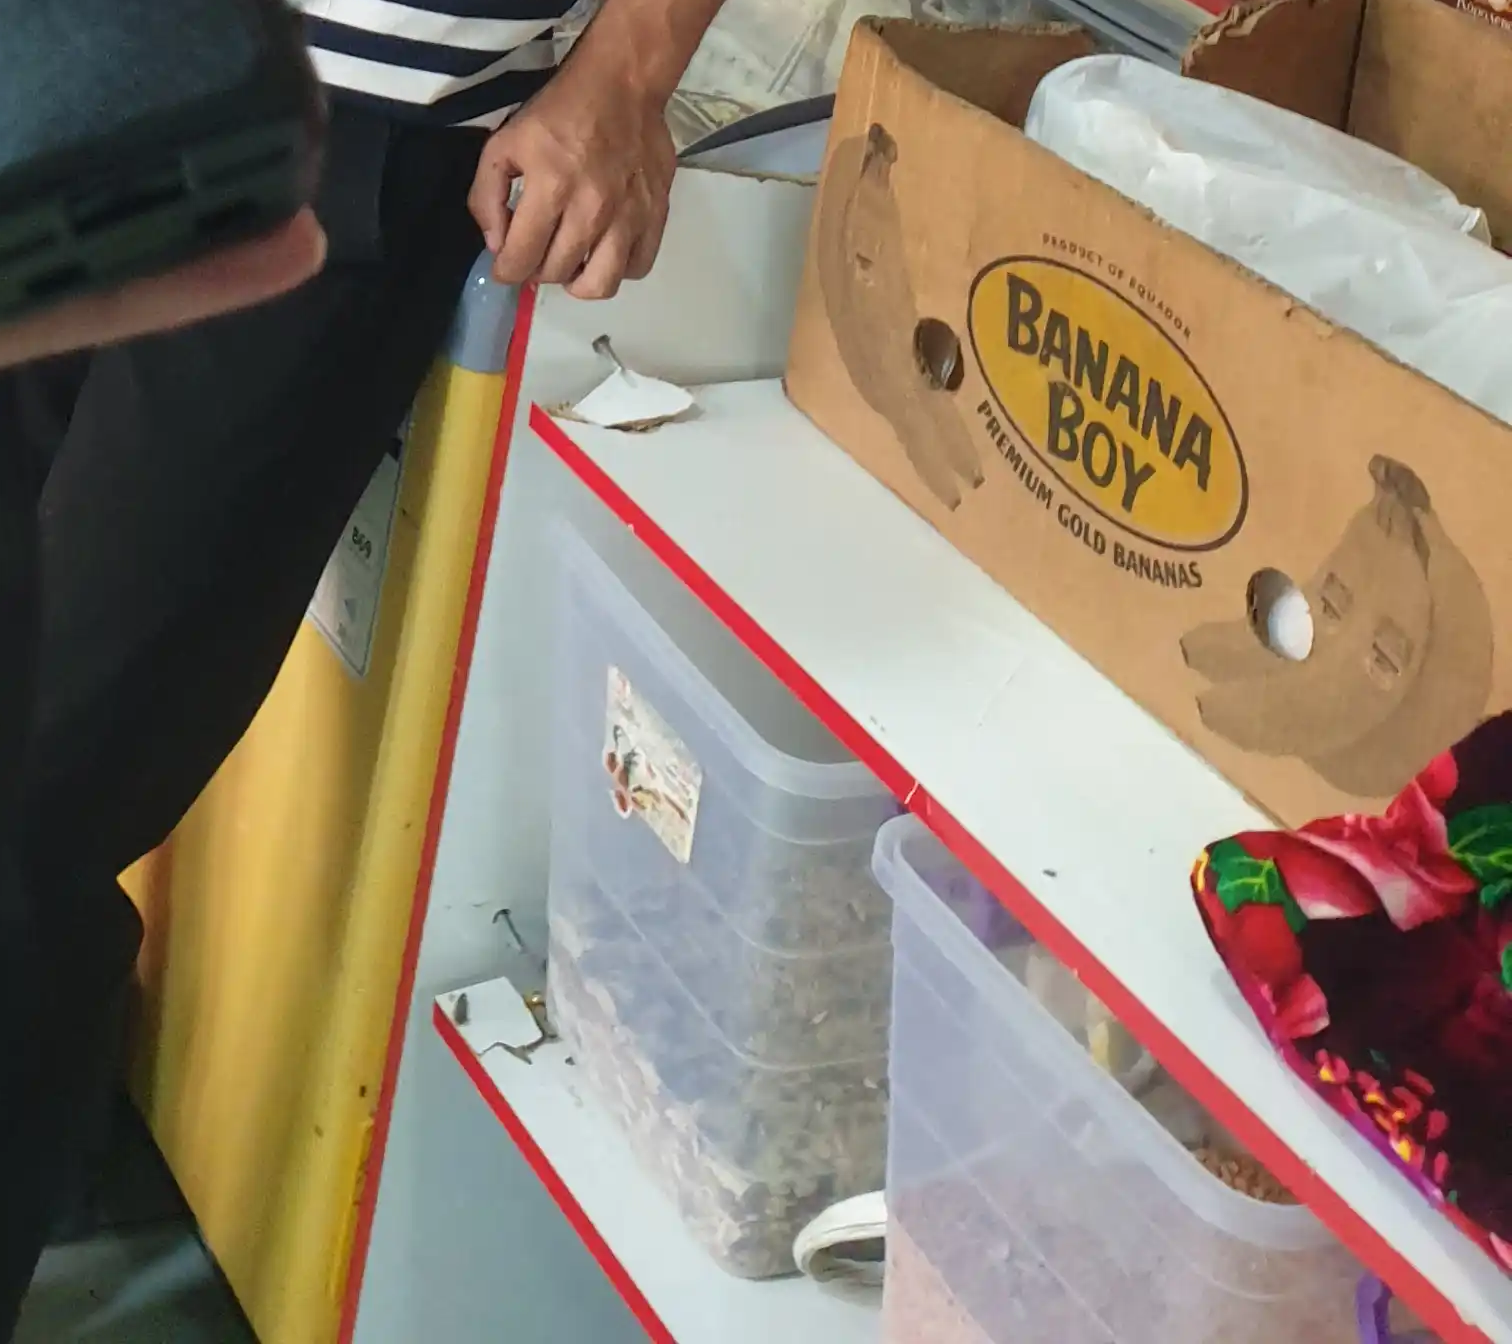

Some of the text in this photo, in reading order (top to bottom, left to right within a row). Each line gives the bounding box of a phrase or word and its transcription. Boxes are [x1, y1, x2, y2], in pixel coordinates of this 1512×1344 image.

[1041, 232, 1104, 267] PRODUCT
[1106, 261, 1125, 282] OF
[1006, 272, 1214, 493] BANANA
[1048, 379, 1157, 513] BOY
[976, 398, 1203, 589] PREMIUM GOLD BANANAS
